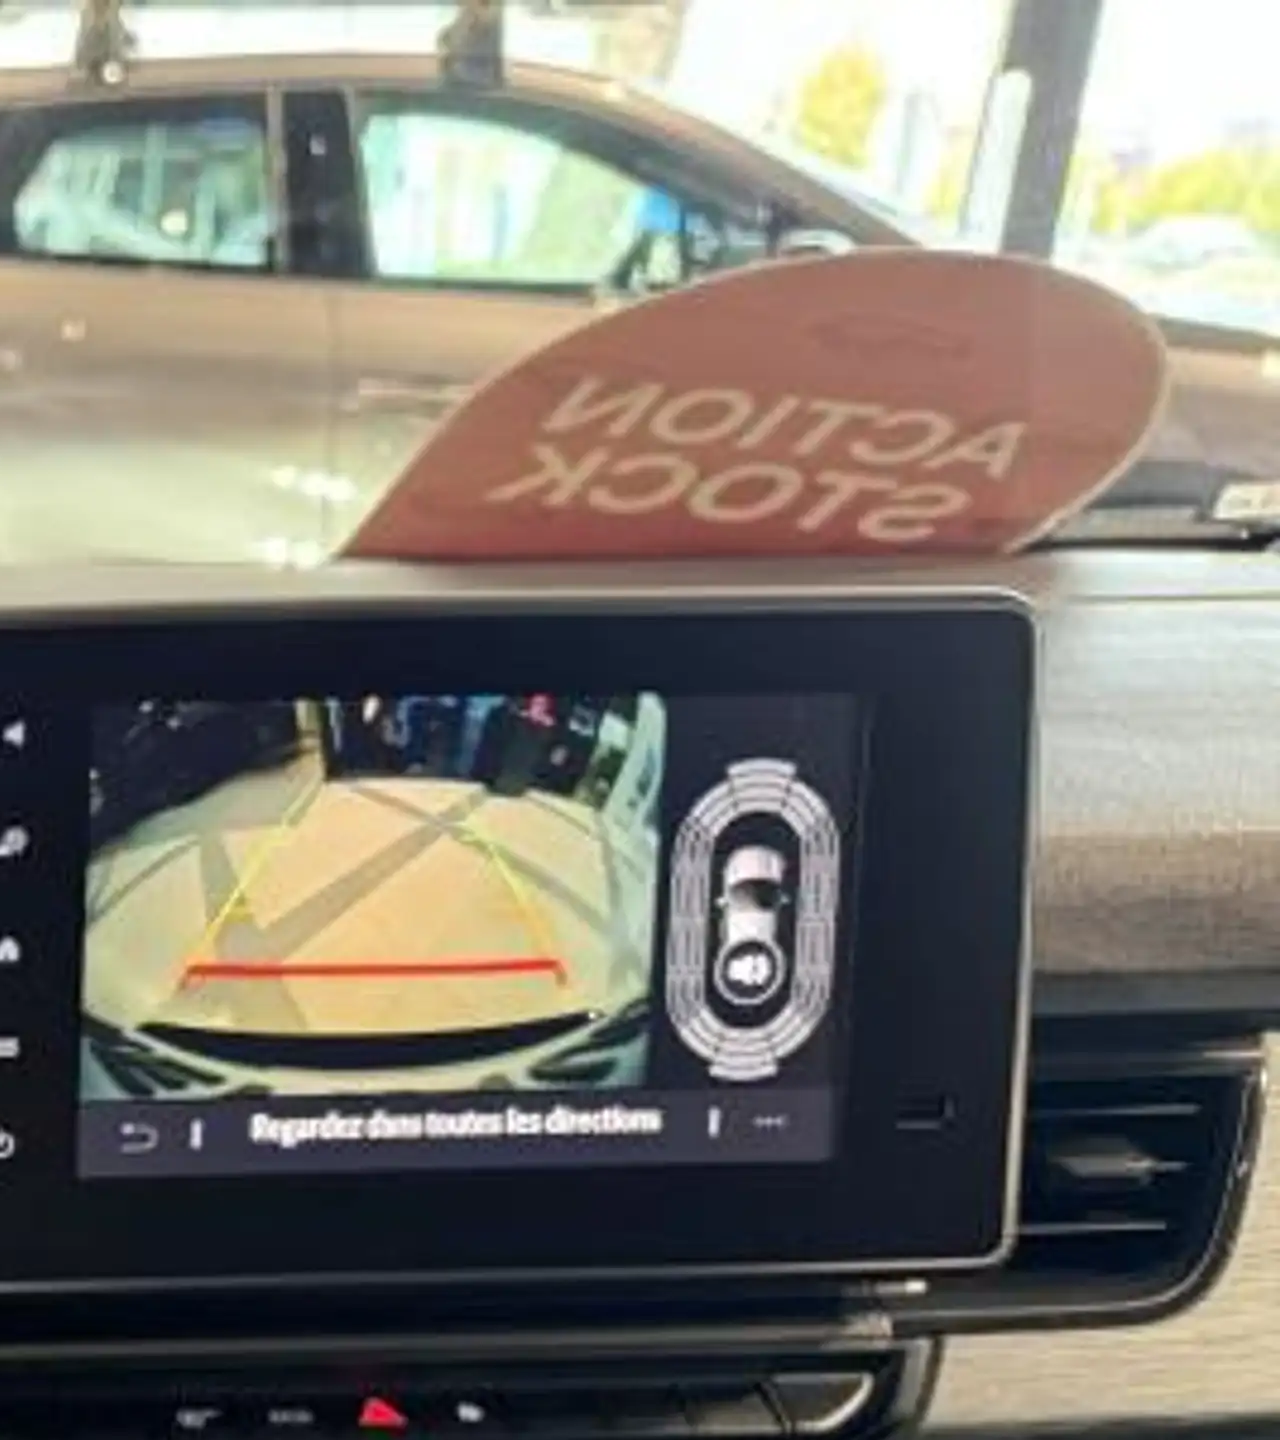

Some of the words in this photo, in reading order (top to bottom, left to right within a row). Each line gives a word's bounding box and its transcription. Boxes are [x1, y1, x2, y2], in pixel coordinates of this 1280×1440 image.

[251, 1109, 364, 1148] Regardez
[366, 1109, 423, 1139] dans
[425, 1109, 503, 1137] toutes
[506, 1106, 541, 1136] les
[544, 1103, 663, 1136] directions
